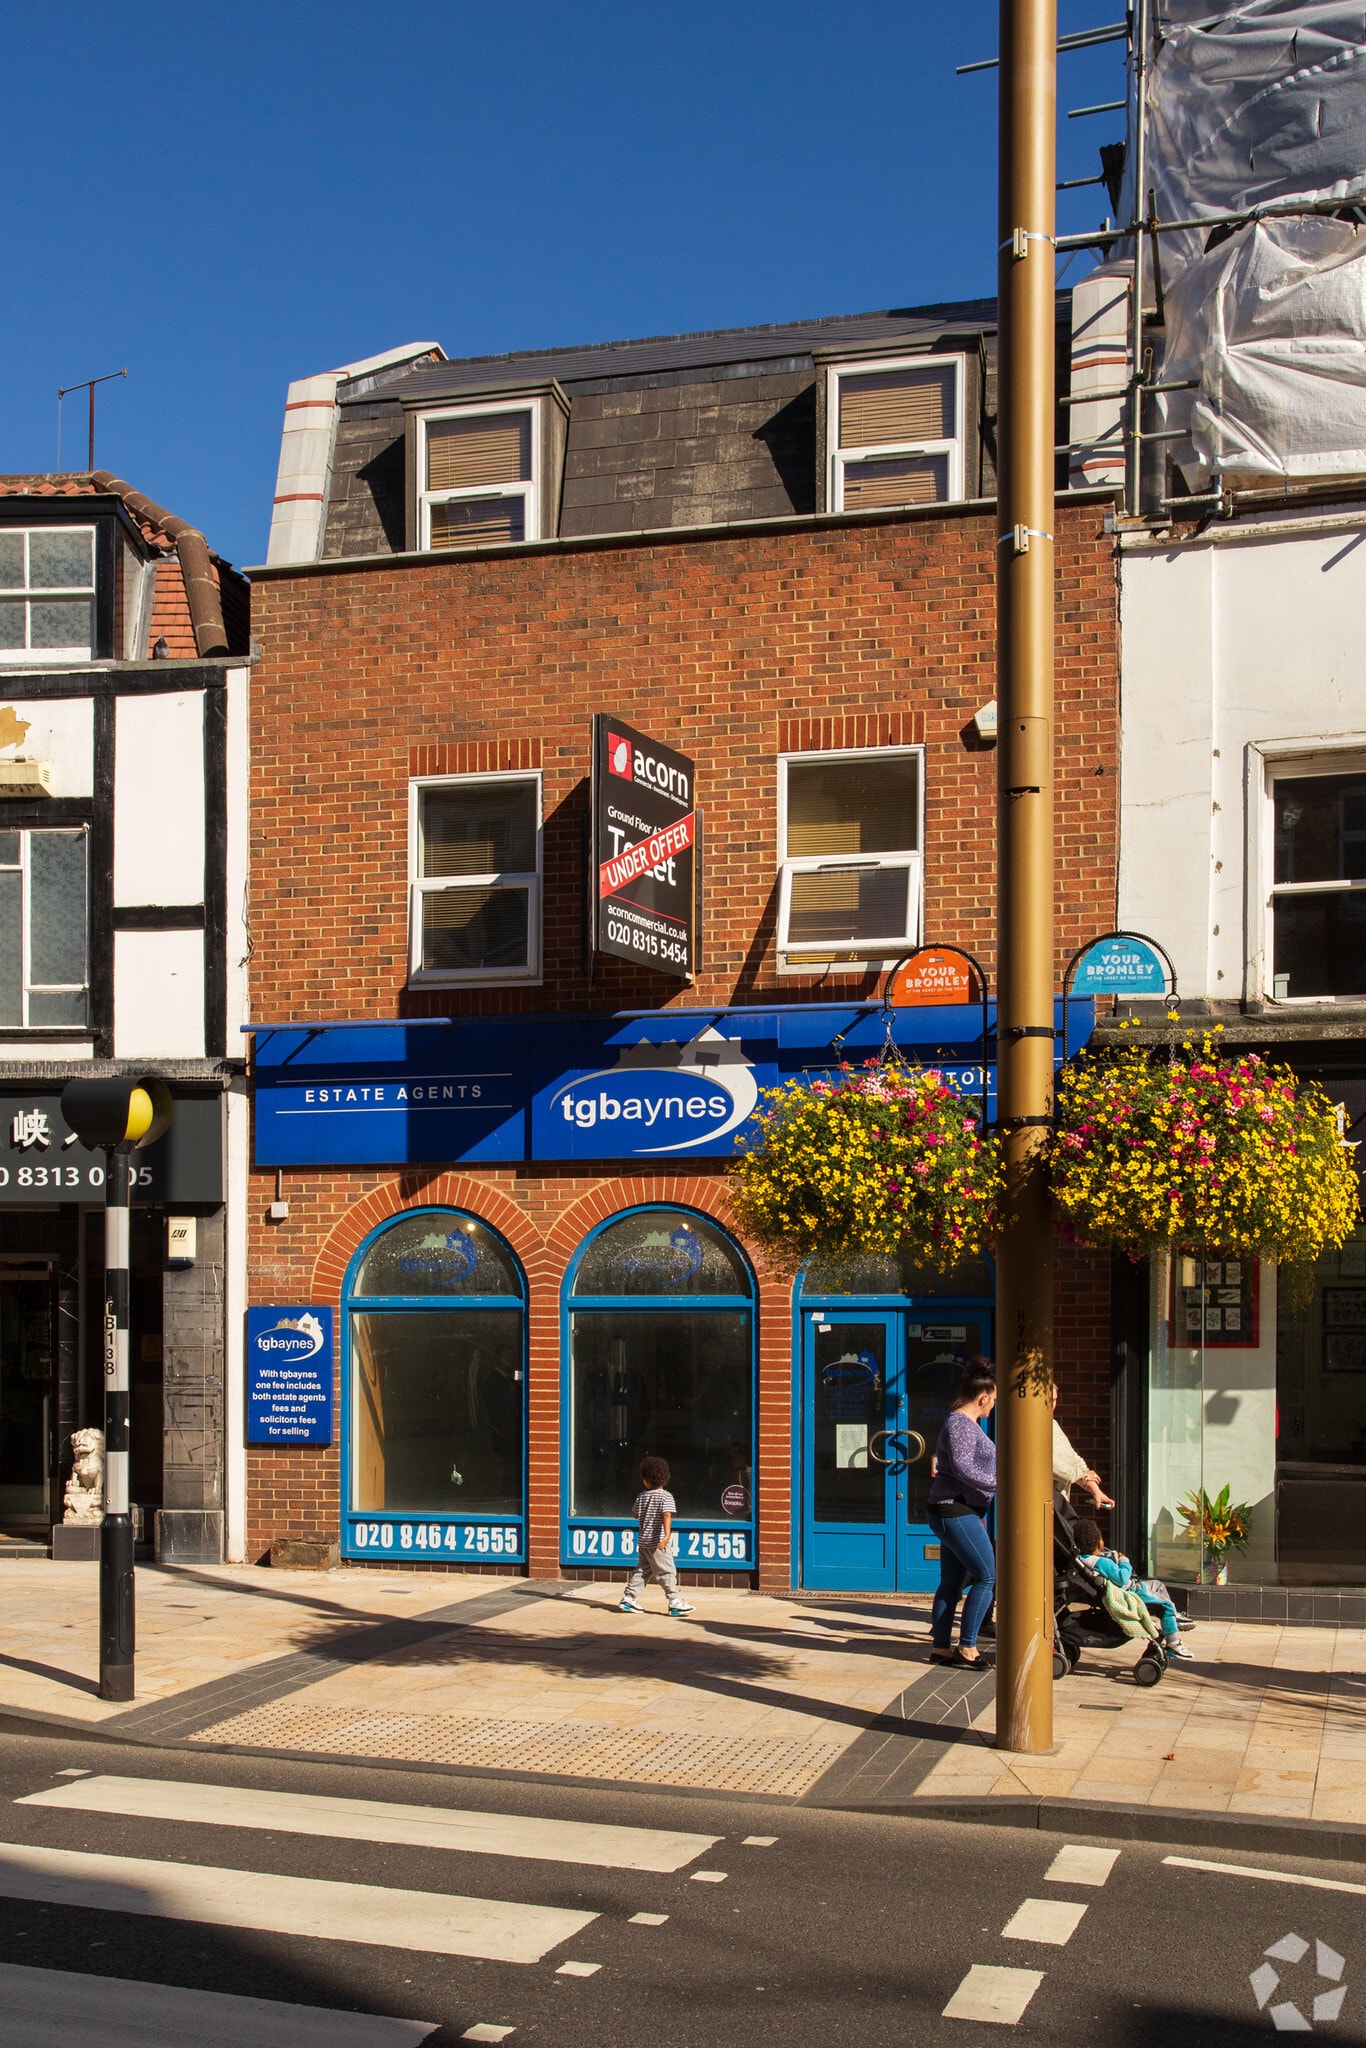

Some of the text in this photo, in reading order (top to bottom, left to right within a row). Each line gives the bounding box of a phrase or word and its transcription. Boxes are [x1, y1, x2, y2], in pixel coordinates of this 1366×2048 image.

[634, 750, 688, 799] acorn
[608, 805, 634, 826] Ground
[635, 817, 652, 834] Floor
[606, 823, 690, 887] UNDER OFFER
[607, 904, 688, 942] acorncommercial.co.uk
[608, 920, 688, 966] 020 8315 5454
[1101, 954, 1140, 965] YOUR
[919, 966, 956, 977] YOUR
[1086, 964, 1154, 975] BROMLEY
[905, 976, 969, 988] BROMLEY
[305, 1085, 483, 1103] ESTATE AGENTS
[561, 1092, 728, 1128] tgbaynes
[17, 1166, 80, 1187] 8313
[257, 1337, 314, 1351] tgbaynes
[259, 1369, 317, 1380] With tgbaynes
[272, 1381, 285, 1389] fee
[286, 1381, 321, 1389] includes
[252, 1392, 326, 1402] both estate agents
[271, 1404, 306, 1412] fees and
[259, 1415, 317, 1424] solicitors fees
[268, 1426, 310, 1437] for selling
[355, 1522, 518, 1553] 020 8464 2555
[572, 1528, 747, 1559] 020 84 2555
